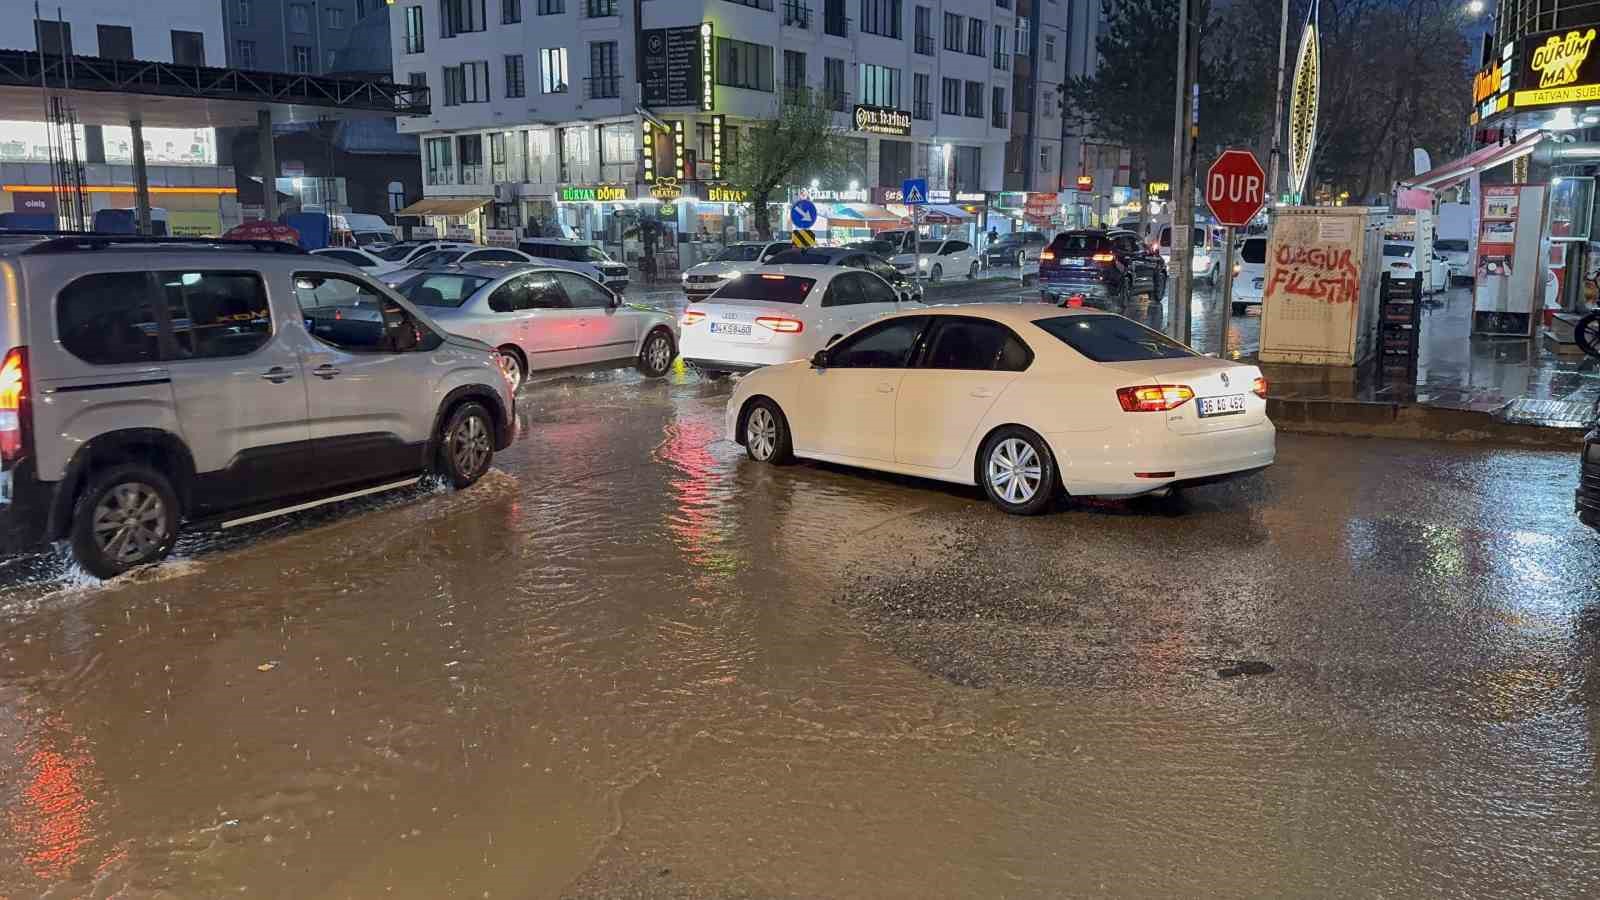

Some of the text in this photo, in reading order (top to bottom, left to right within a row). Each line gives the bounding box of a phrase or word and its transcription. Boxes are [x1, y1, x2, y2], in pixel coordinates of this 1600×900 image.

[1541, 59, 1580, 87] MAX
[1534, 87, 1569, 101] TATVAN
[563, 186, 625, 201] BÜRYAN DÖNER
[1211, 173, 1260, 203] DUR
[1203, 399, 1214, 413] 36
